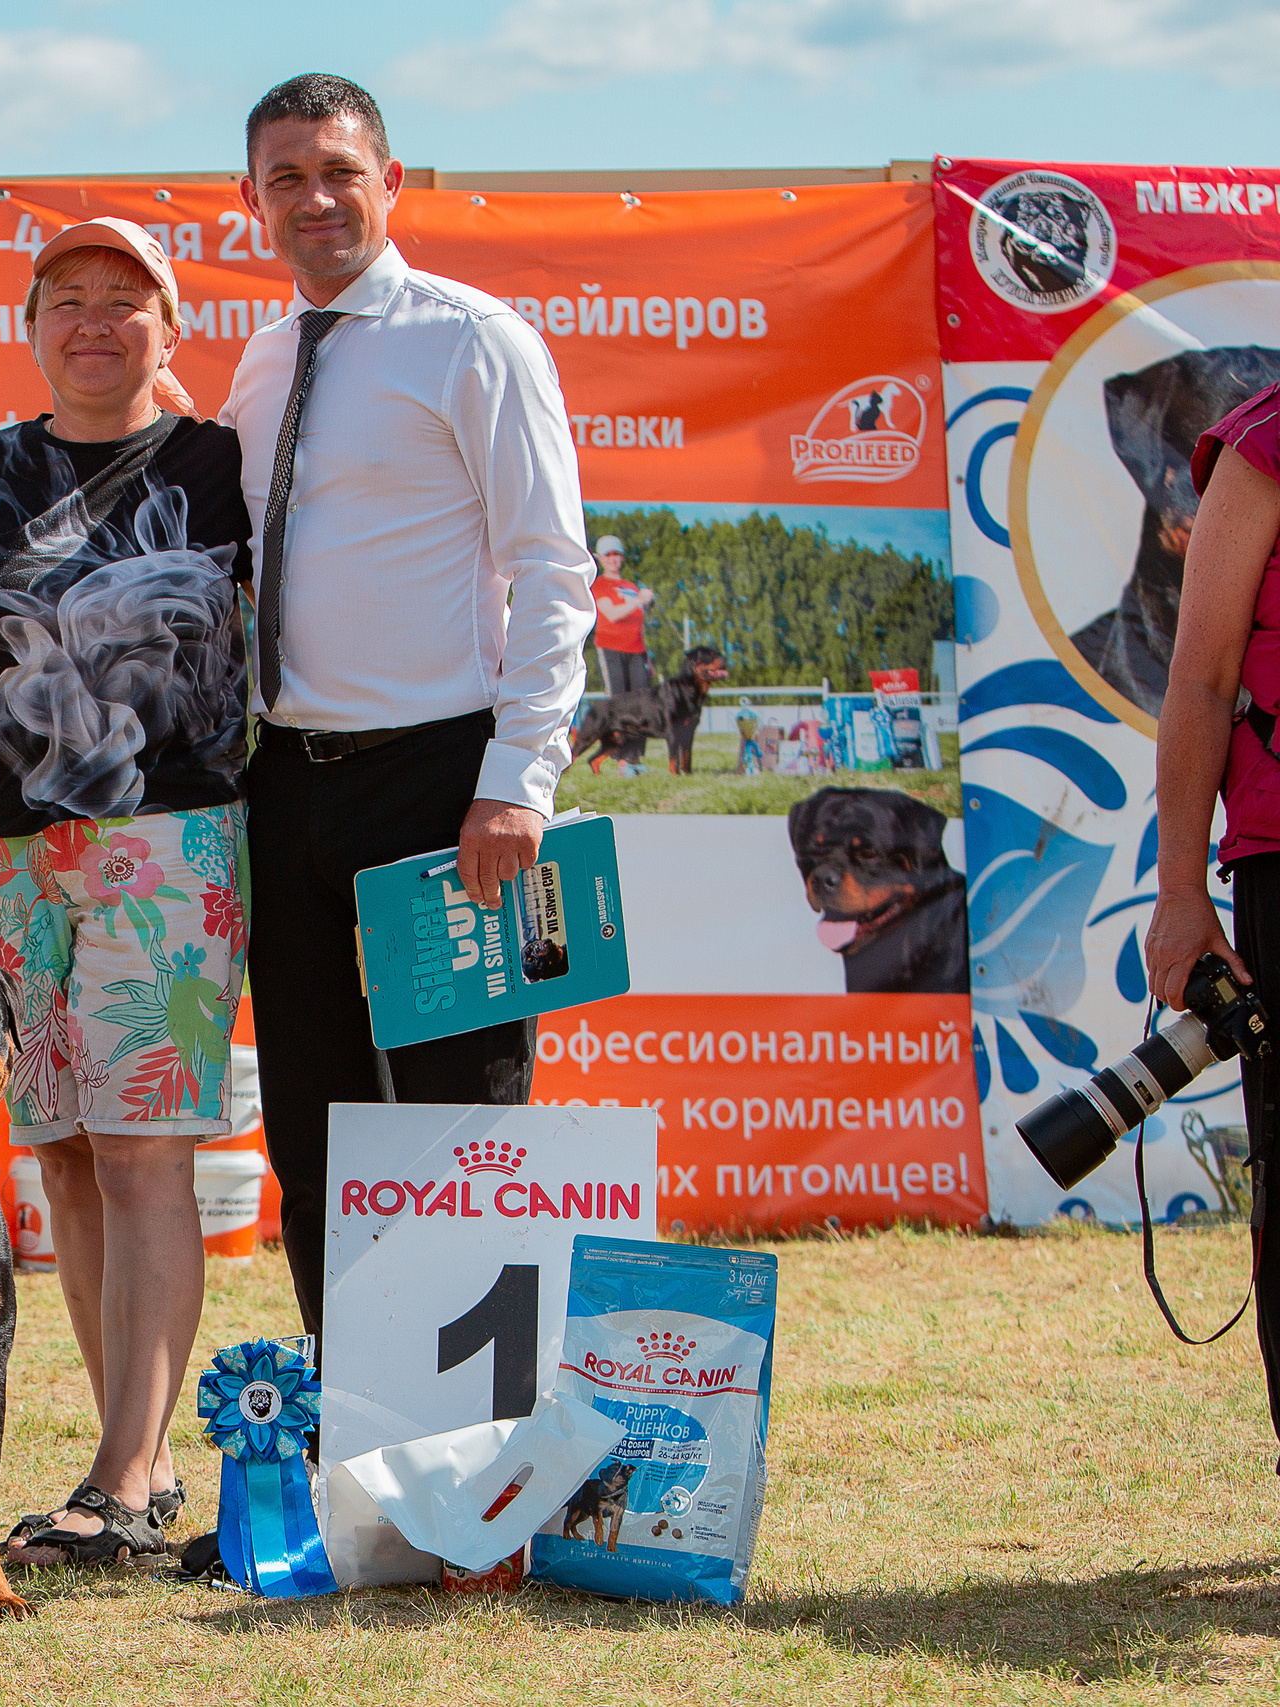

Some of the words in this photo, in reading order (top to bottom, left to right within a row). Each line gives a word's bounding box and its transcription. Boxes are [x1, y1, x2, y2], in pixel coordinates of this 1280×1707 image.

[1135, 180, 1280, 216] МЕЖР
[219, 210, 278, 261] 20
[499, 283, 768, 350] вейлеров
[570, 414, 685, 449] тавки
[792, 437, 918, 464] PROFIFEED
[541, 866, 554, 888] CUP
[544, 887, 558, 919] Silver
[594, 876, 606, 925] TABOOSPORT
[483, 914, 505, 969] Silver
[537, 1019, 960, 1074] офессиональный
[684, 1098, 966, 1140] кормлению
[717, 1153, 970, 1202] питомцев!
[341, 1179, 483, 1217] ROYAL
[494, 1182, 641, 1220] CANIN
[728, 1269, 736, 1283] 3
[437, 1264, 539, 1422] 1
[584, 1352, 656, 1384] ROYAL
[663, 1364, 737, 1388] CANIN
[625, 1405, 668, 1421] PUPPY
[631, 1421, 690, 1439] ЩЕНКОВ
[628, 1440, 650, 1449] СОБАК
